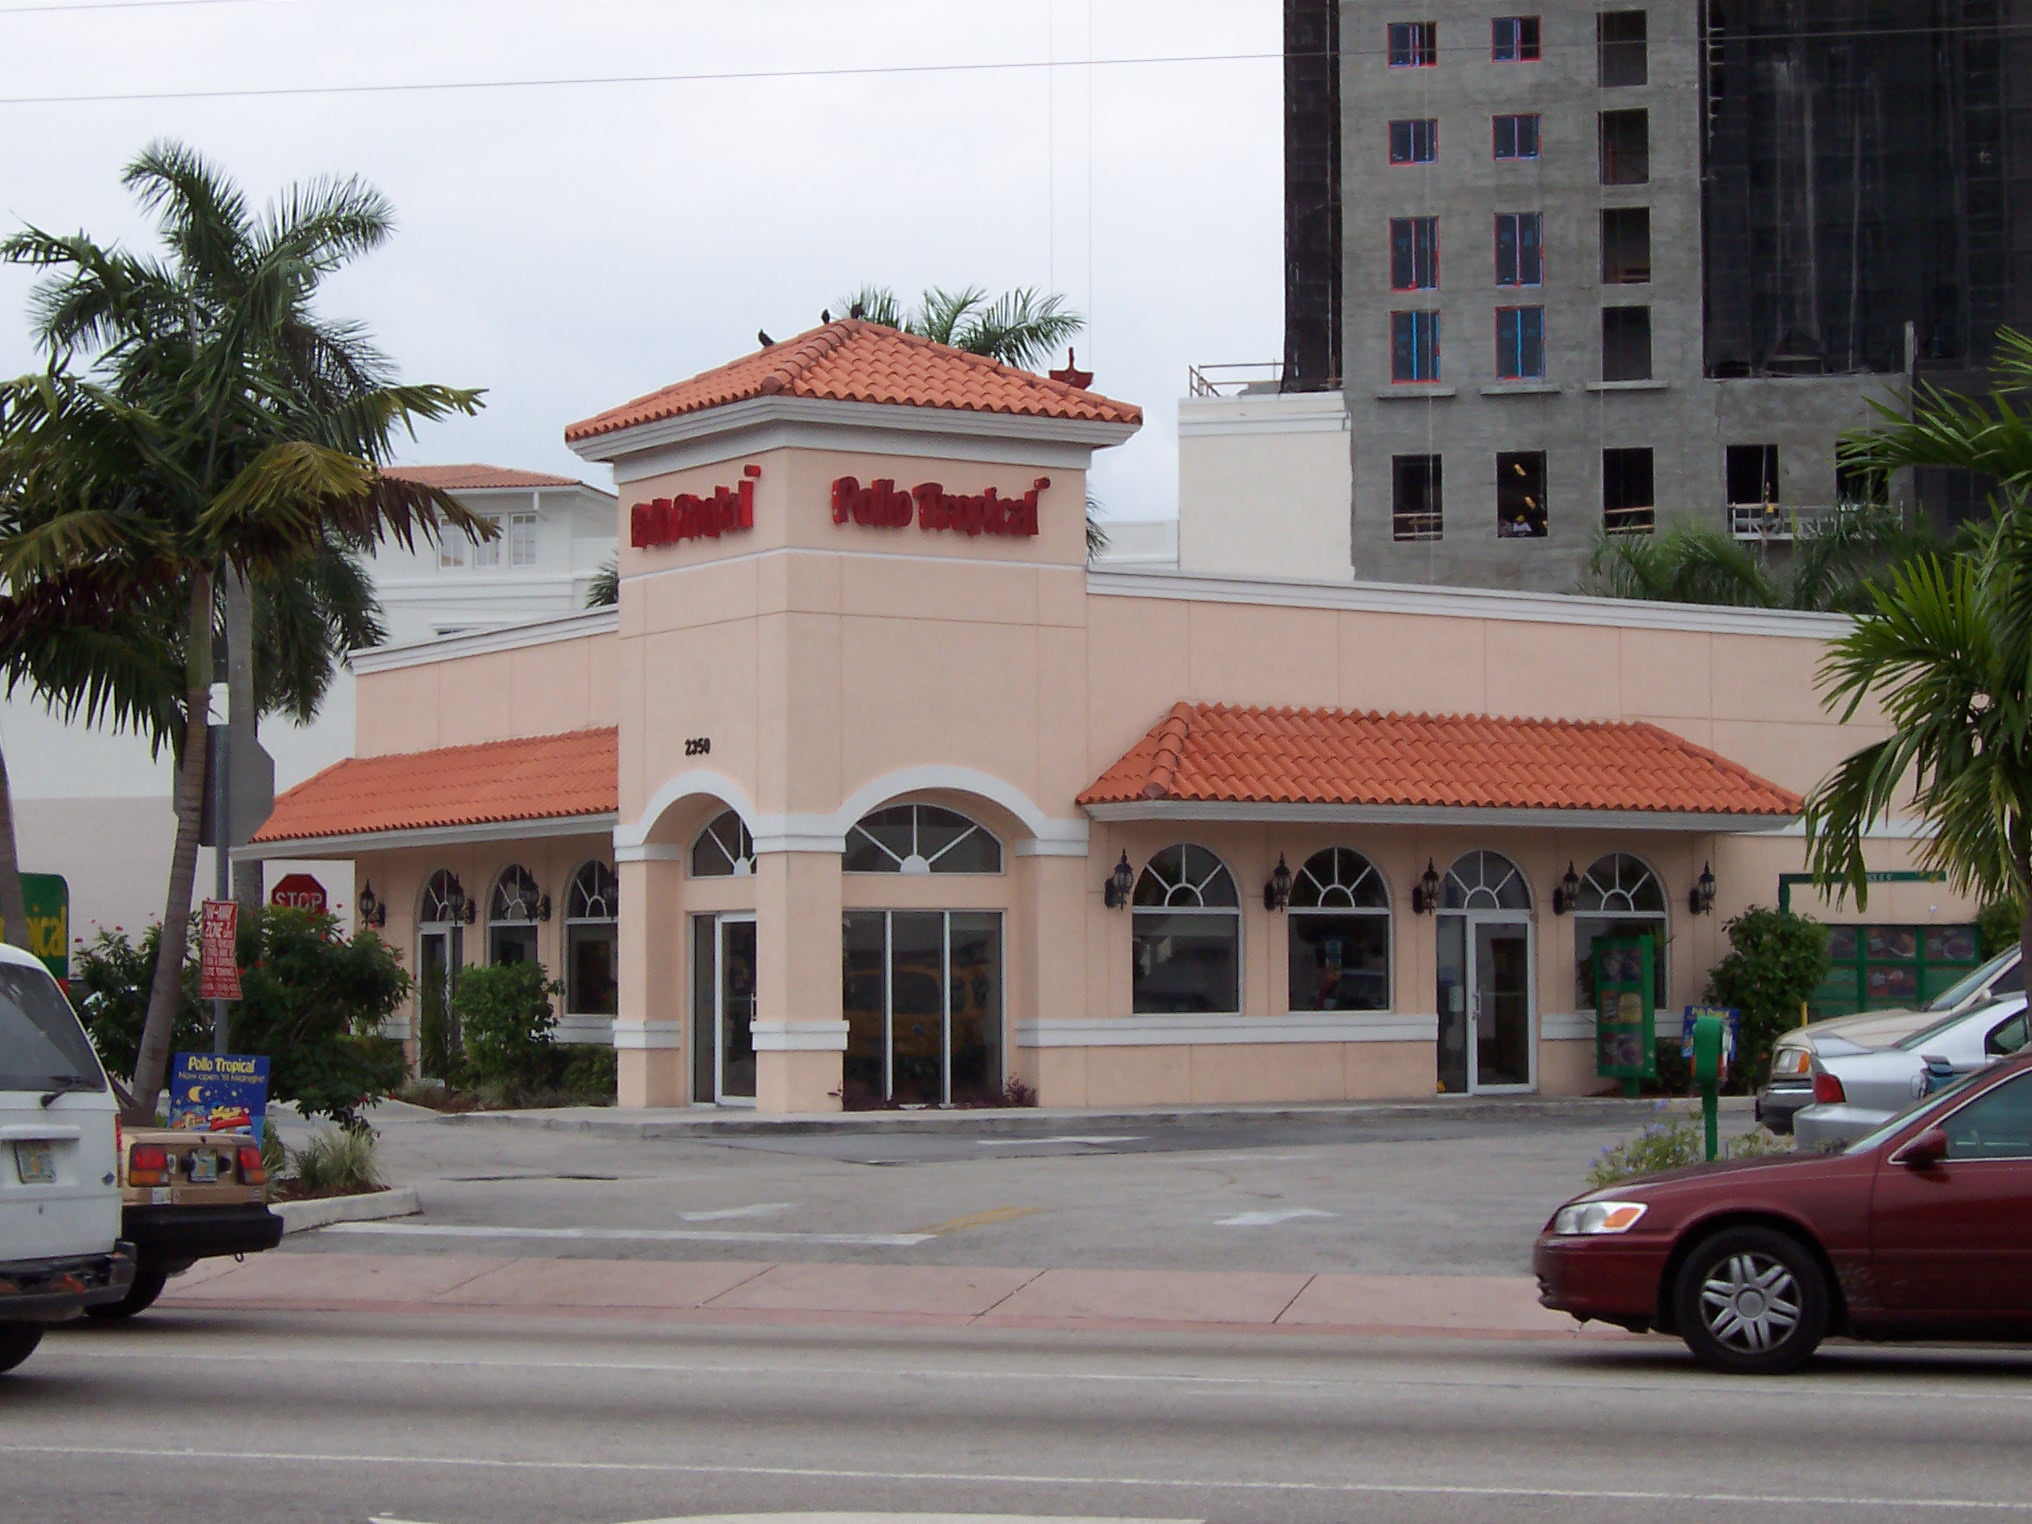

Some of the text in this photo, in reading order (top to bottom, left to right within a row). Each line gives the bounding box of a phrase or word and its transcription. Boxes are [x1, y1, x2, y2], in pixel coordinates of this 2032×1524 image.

[832, 476, 1041, 537] Pollo Tropical
[275, 891, 323, 912] STOP
[188, 1055, 256, 1073] Pollo Tropical
